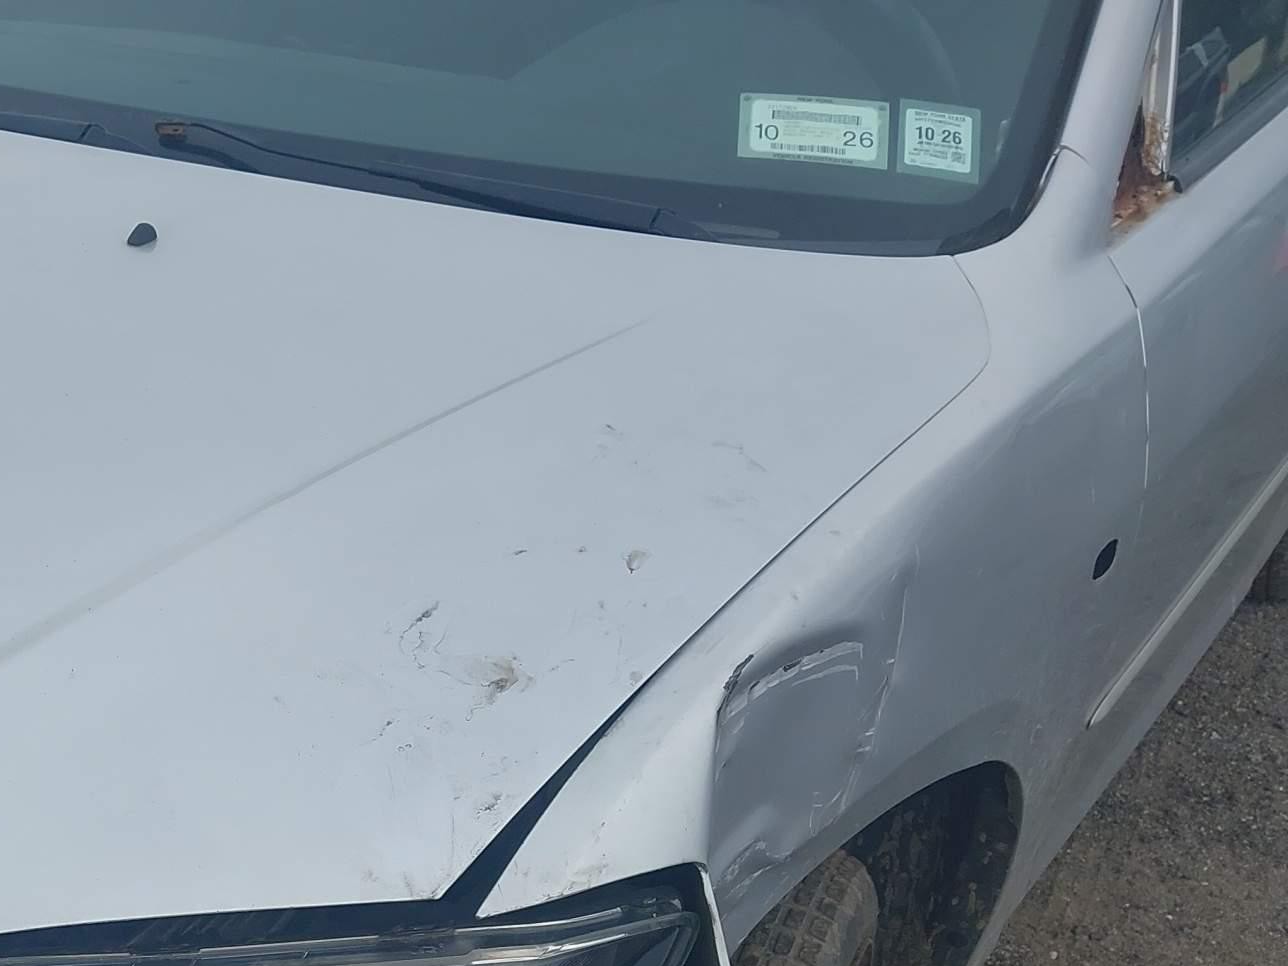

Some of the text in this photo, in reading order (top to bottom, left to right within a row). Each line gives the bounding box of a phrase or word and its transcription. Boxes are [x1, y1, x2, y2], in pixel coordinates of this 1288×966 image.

[755, 123, 779, 140] 10
[843, 131, 874, 148] 26
[915, 126, 963, 145] 10 26
